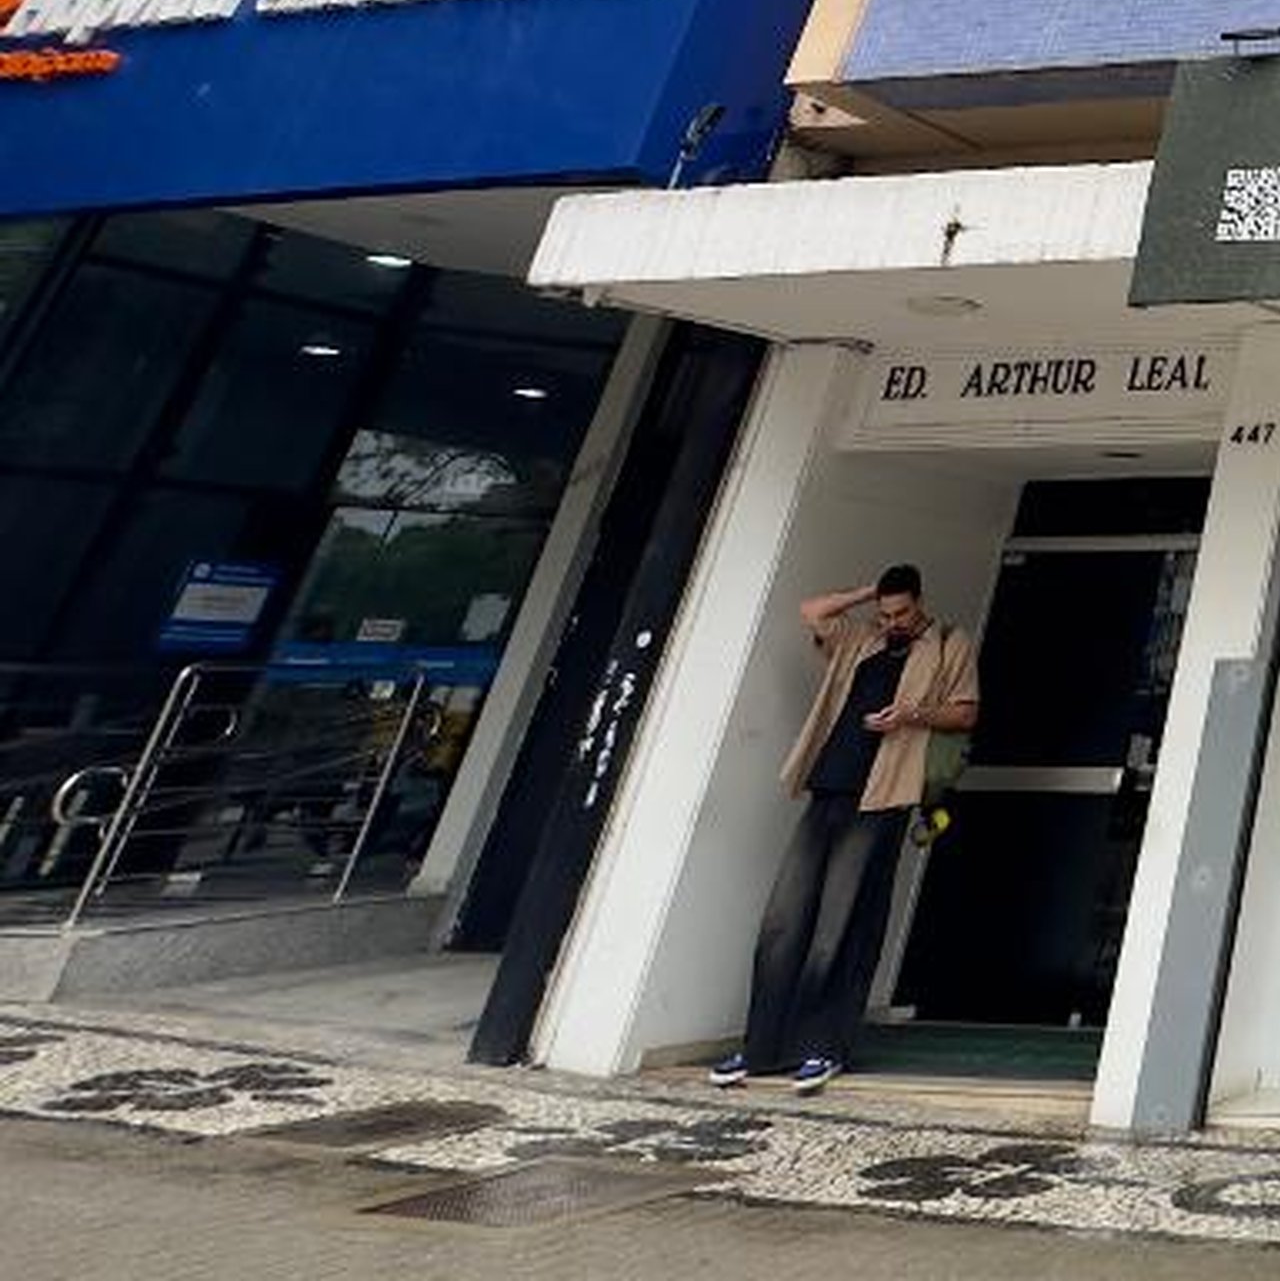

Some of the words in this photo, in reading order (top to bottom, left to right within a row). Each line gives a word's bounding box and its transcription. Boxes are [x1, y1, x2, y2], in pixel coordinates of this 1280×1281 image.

[882, 365, 928, 401] ED.
[960, 359, 1096, 398] ARTHUR
[1127, 356, 1210, 392] LEAL
[1229, 423, 1276, 445] 447
